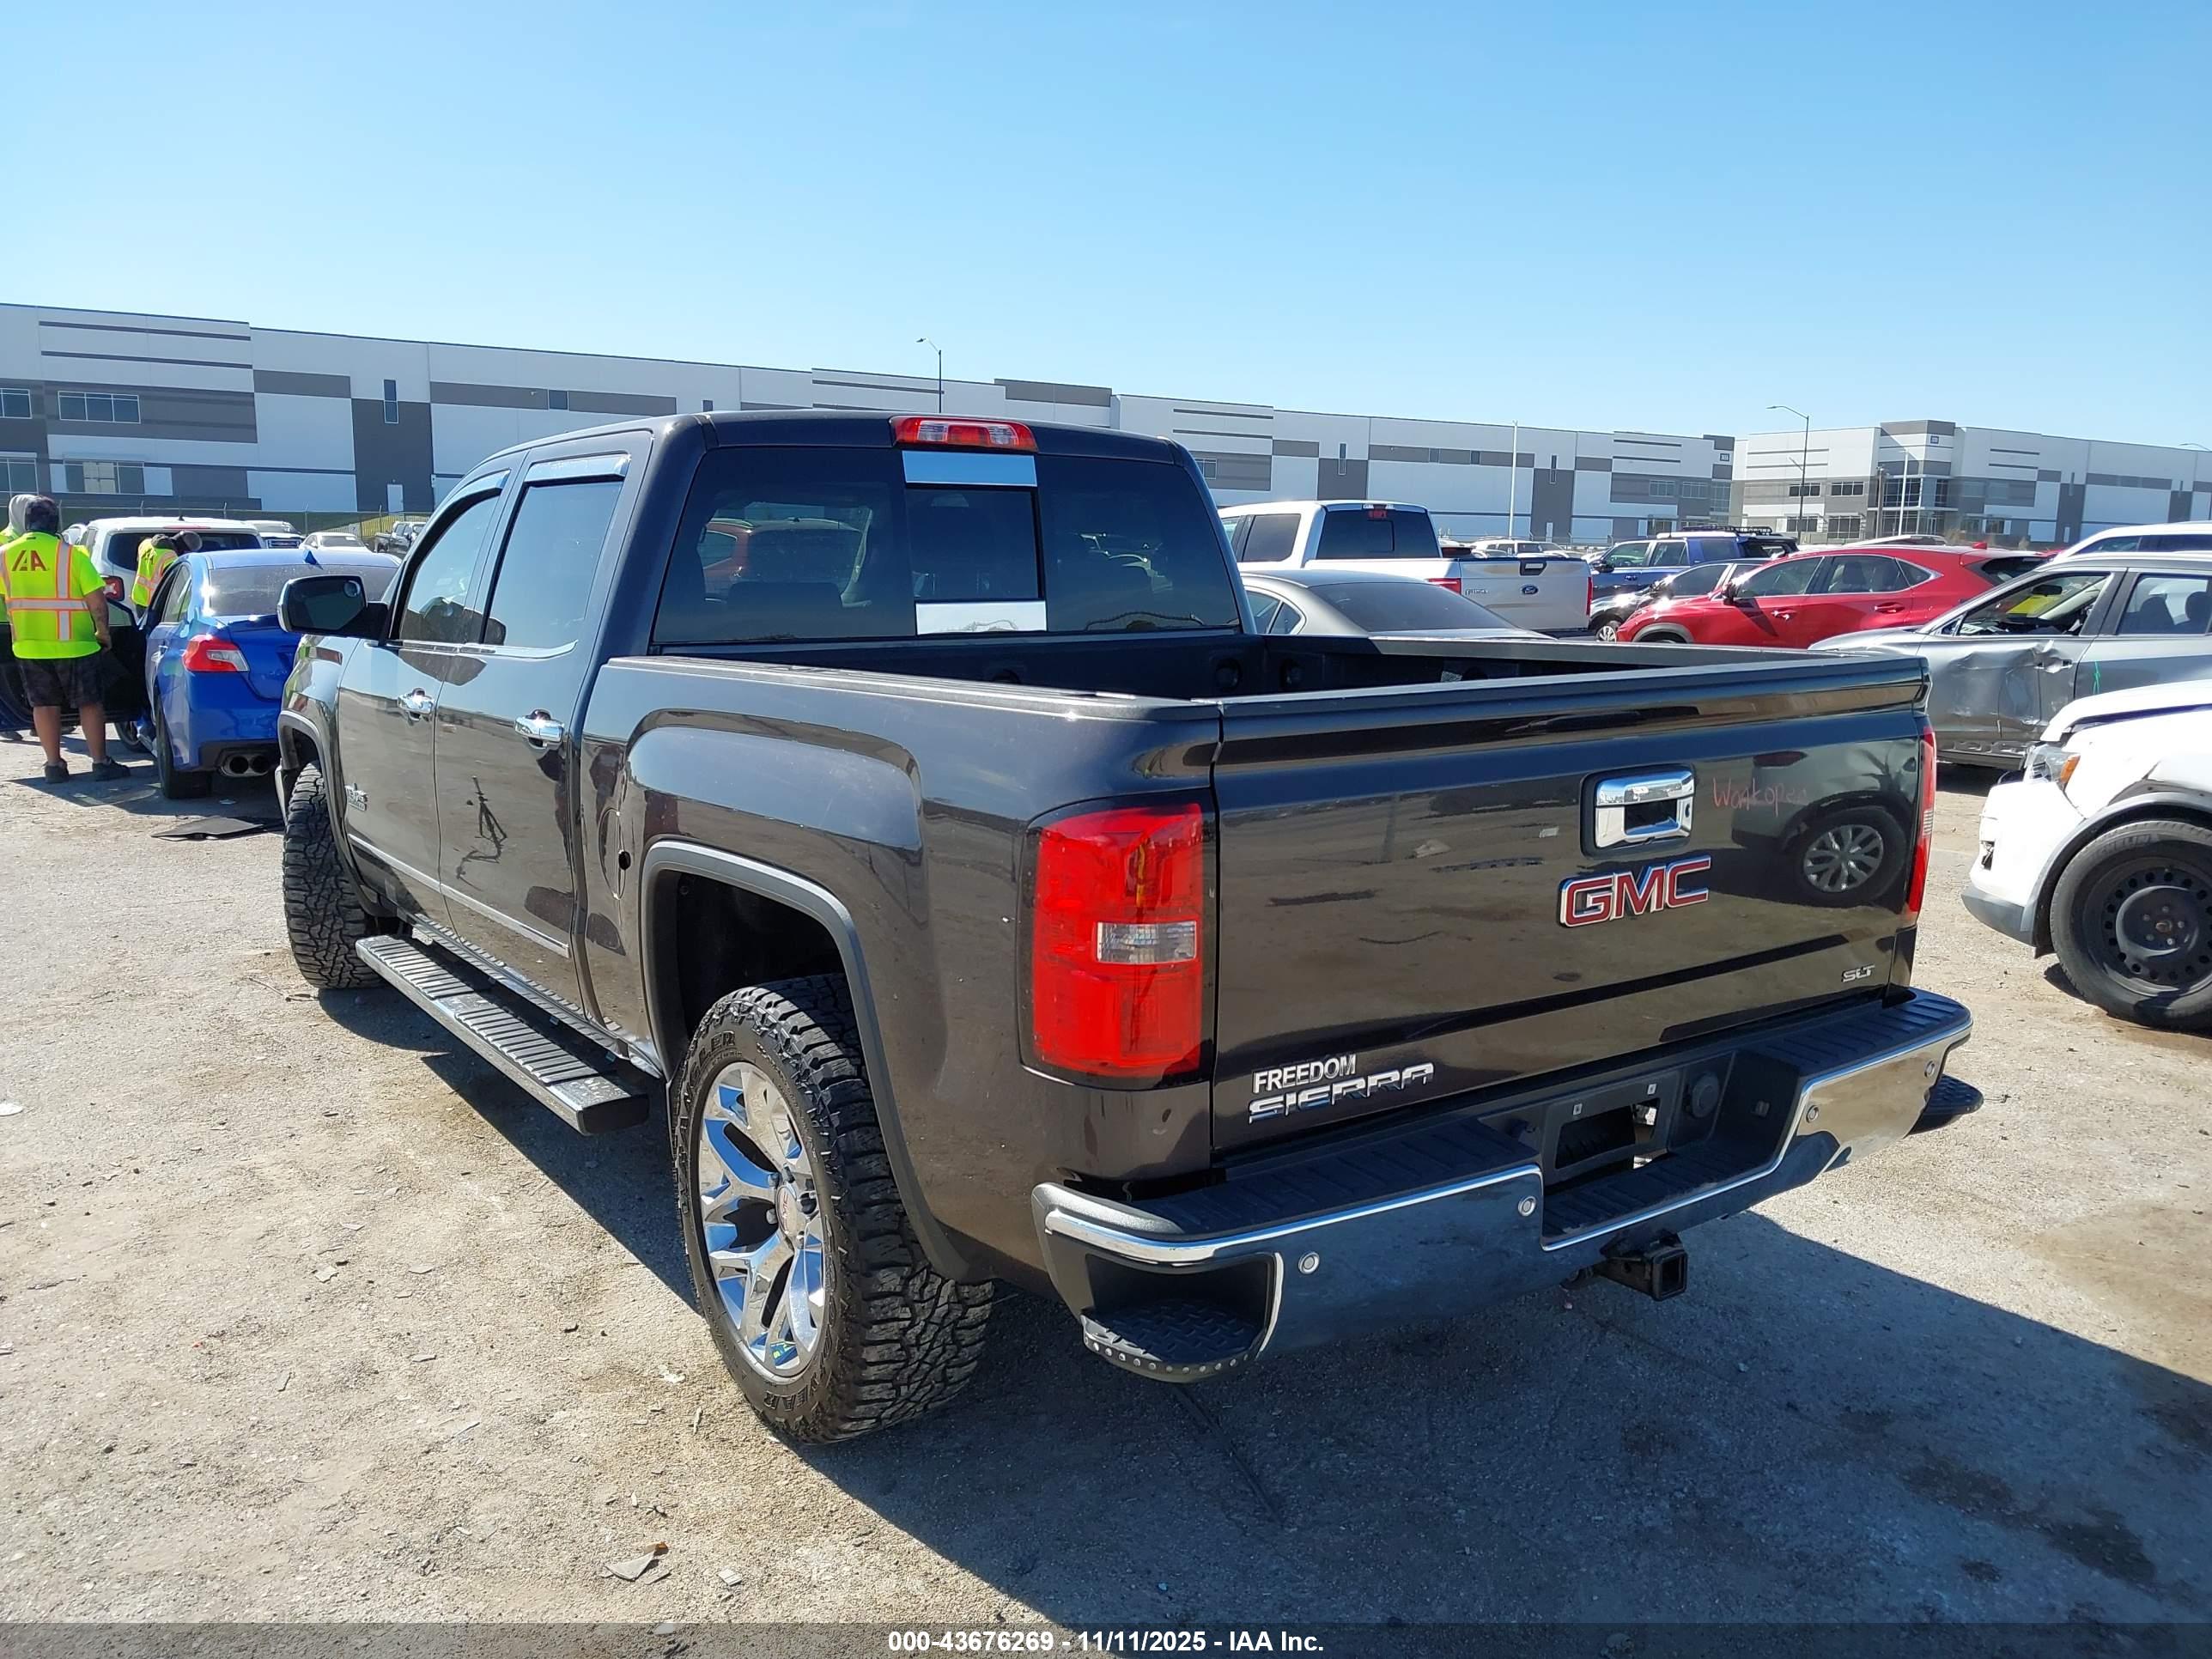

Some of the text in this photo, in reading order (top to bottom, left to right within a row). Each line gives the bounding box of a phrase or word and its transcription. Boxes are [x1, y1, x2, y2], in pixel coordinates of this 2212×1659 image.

[1559, 854, 1711, 927] GMC
[1841, 963, 1875, 983] SLT
[1248, 1062, 1435, 1124] SIERRA
[1252, 1054, 1357, 1094] FREEDOM
